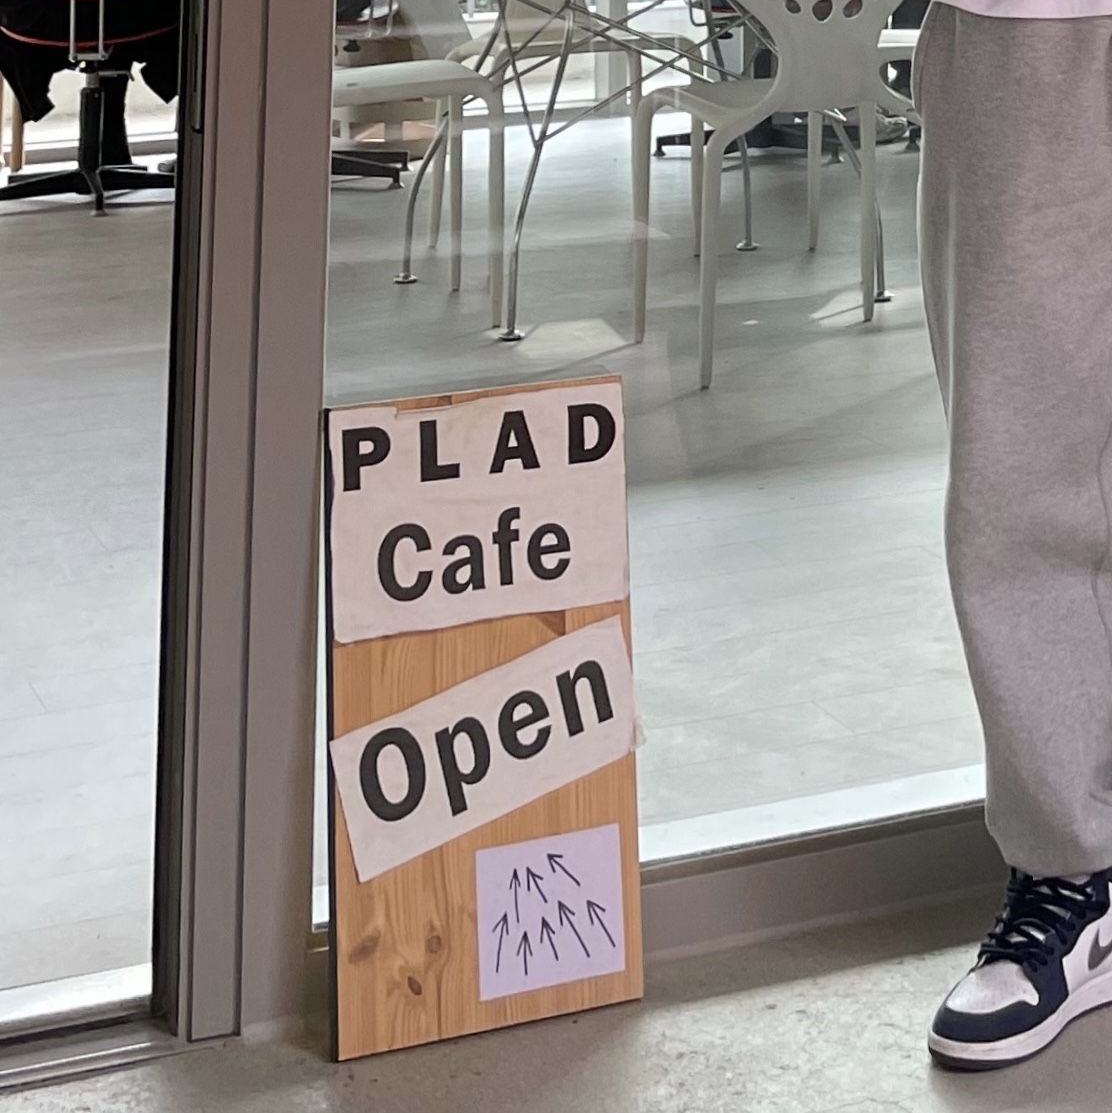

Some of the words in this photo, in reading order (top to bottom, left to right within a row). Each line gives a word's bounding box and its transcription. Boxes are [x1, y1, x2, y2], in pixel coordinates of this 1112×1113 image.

[341, 402, 616, 492] PLAD
[377, 506, 571, 602] Cafe
[358, 658, 614, 823] Open
